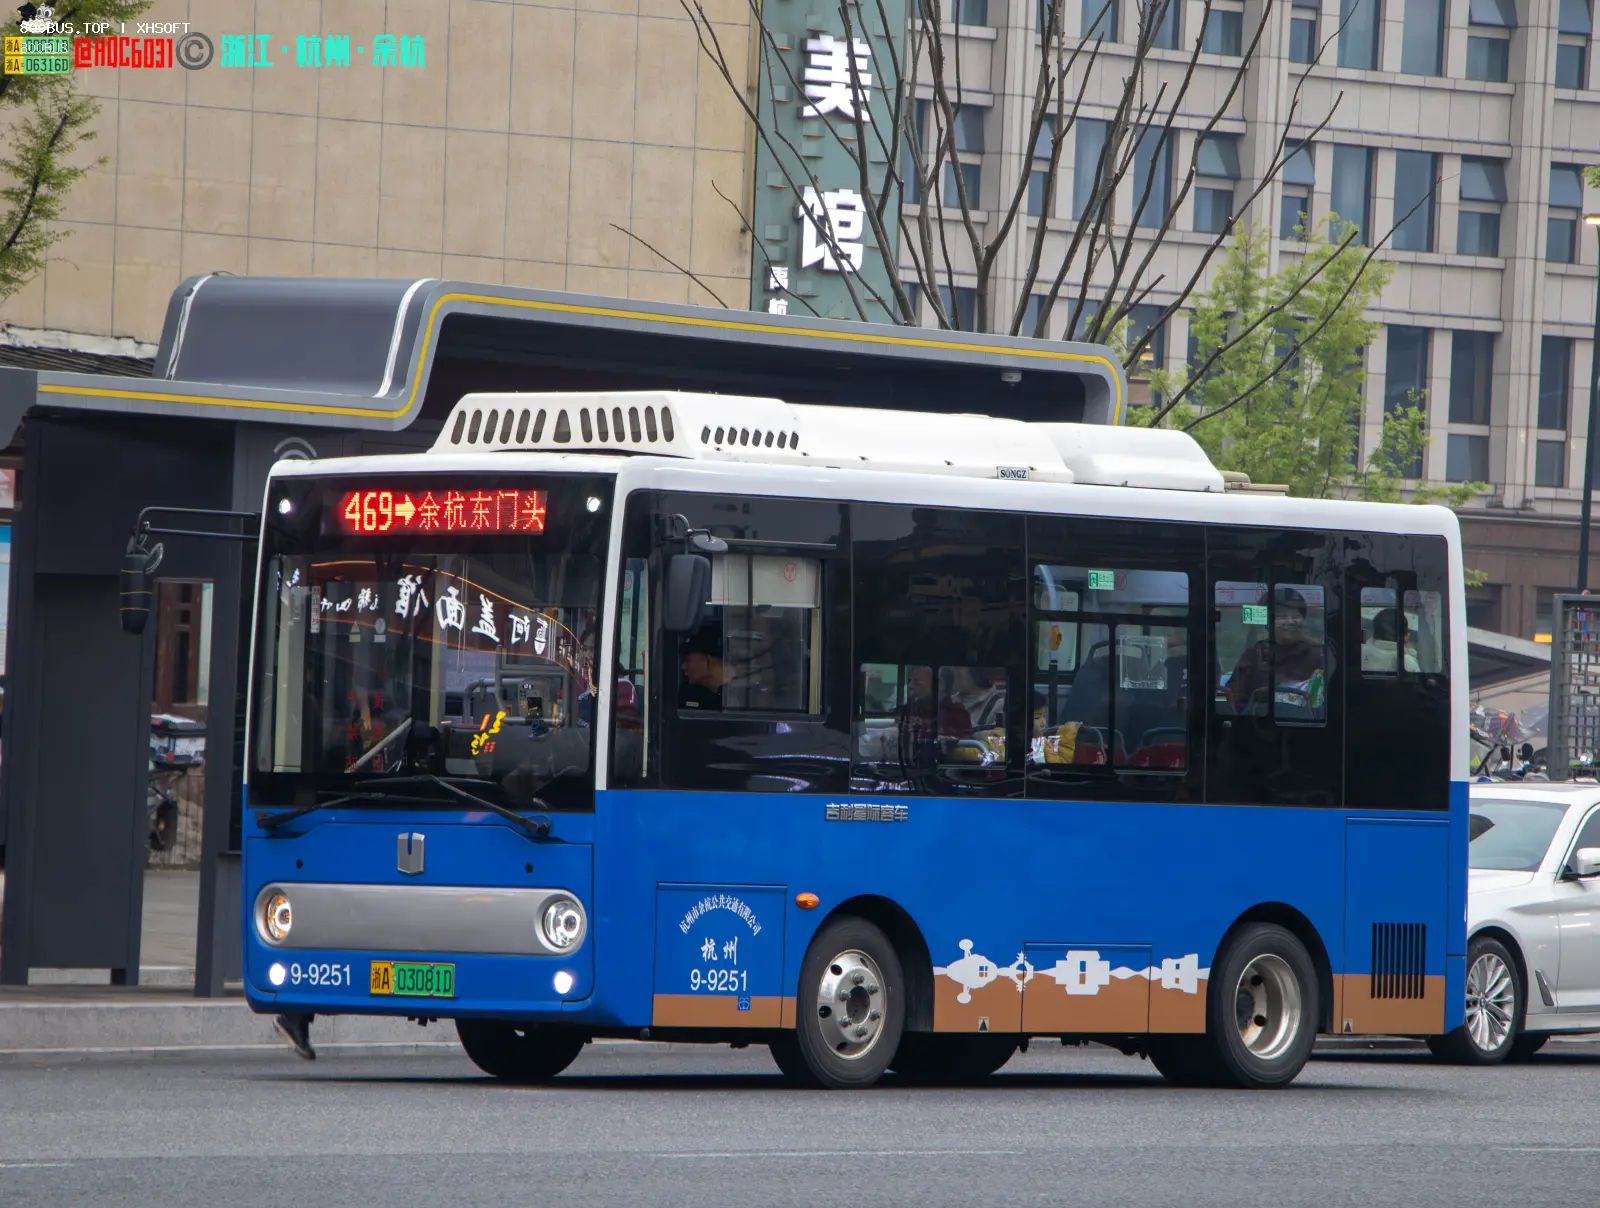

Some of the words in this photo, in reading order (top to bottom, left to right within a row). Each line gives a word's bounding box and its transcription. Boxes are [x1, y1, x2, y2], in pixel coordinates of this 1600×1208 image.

[1000, 469, 1027, 479] SONGZ
[344, 491, 393, 531] 469
[417, 490, 545, 530] 余杭东门头
[679, 893, 762, 936] 杭州市余杭公共交通有限公司
[701, 936, 738, 965] 杭州
[290, 963, 351, 986] 9-9251
[690, 968, 747, 991] 9-9251
